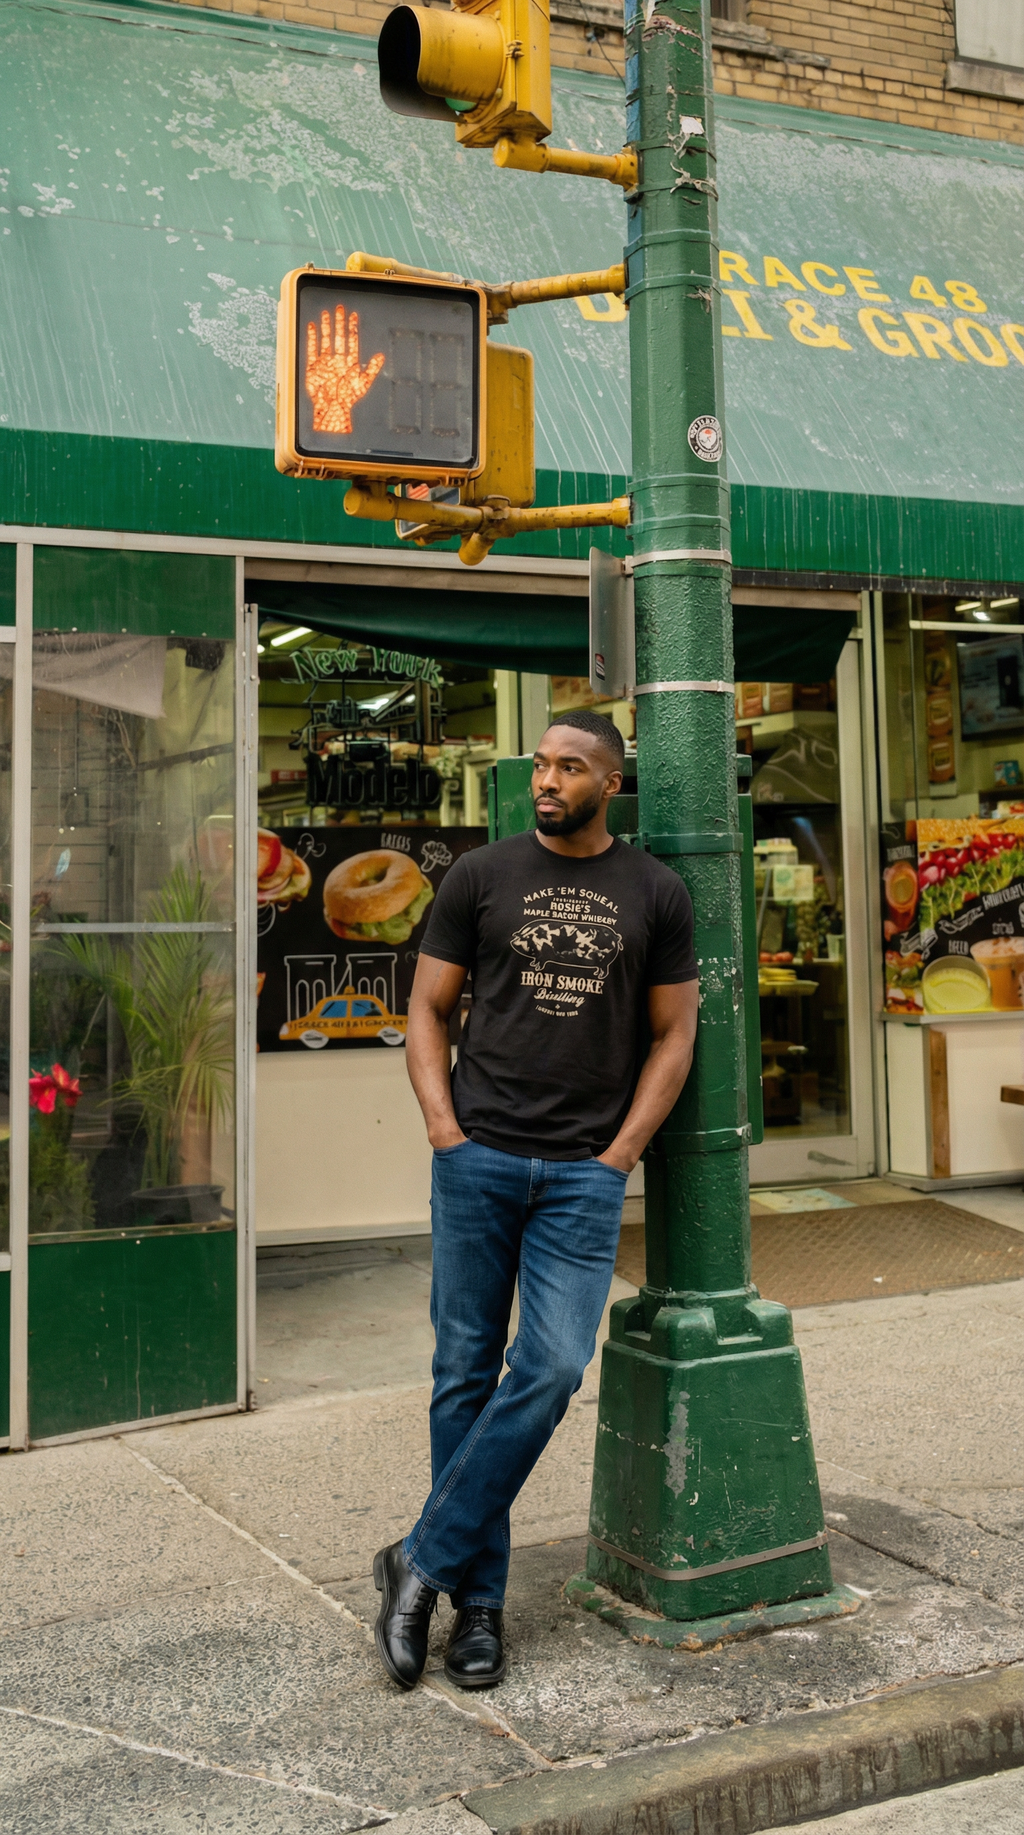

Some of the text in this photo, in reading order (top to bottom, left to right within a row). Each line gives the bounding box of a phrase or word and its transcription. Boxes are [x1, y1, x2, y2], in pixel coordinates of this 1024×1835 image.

[909, 275, 988, 313] 48
[784, 299, 853, 351] &
[290, 646, 358, 684] New
[523, 888, 555, 904] MAKE
[557, 887, 576, 895] 'EM
[579, 889, 619, 914] SQUEAL
[523, 908, 551, 917] MAPLE
[552, 911, 579, 920] BACON
[520, 971, 605, 994] IRON SMOKE
